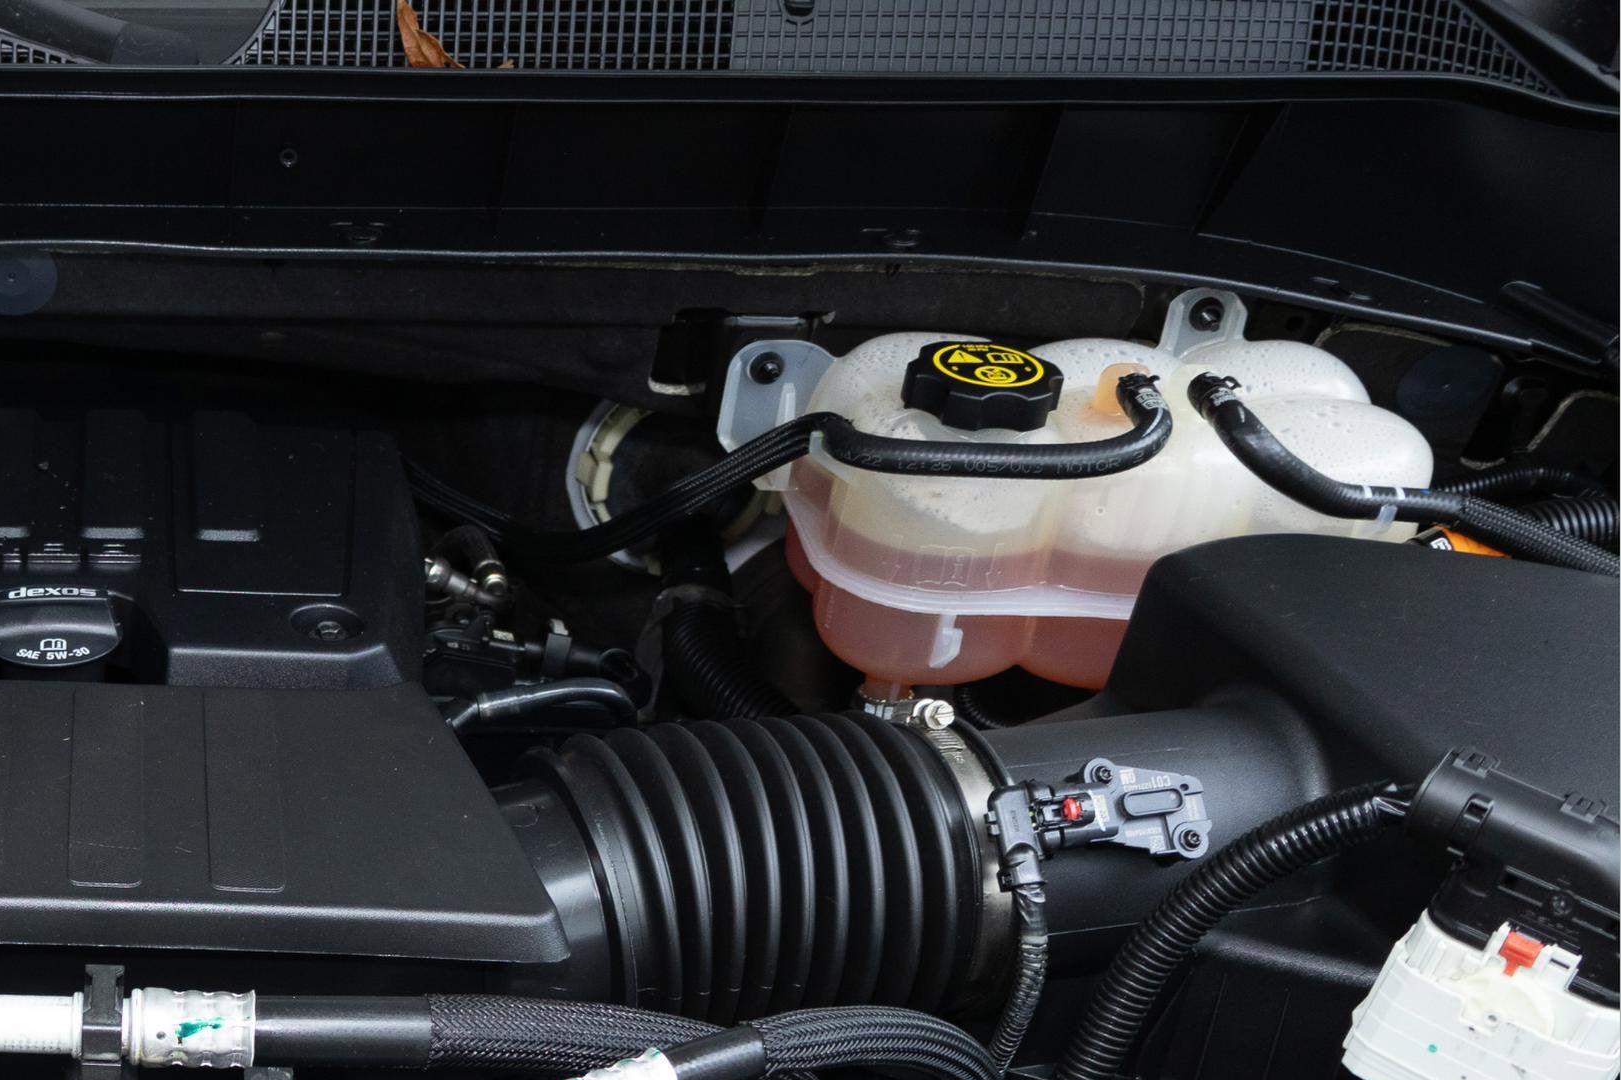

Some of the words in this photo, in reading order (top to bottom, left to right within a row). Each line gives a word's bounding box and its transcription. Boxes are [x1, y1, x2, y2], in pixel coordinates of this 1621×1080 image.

[1057, 457, 1121, 476] MOTOR
[8, 587, 97, 599] dexos
[16, 648, 41, 660] SAE
[46, 646, 91, 660] 5W-30
